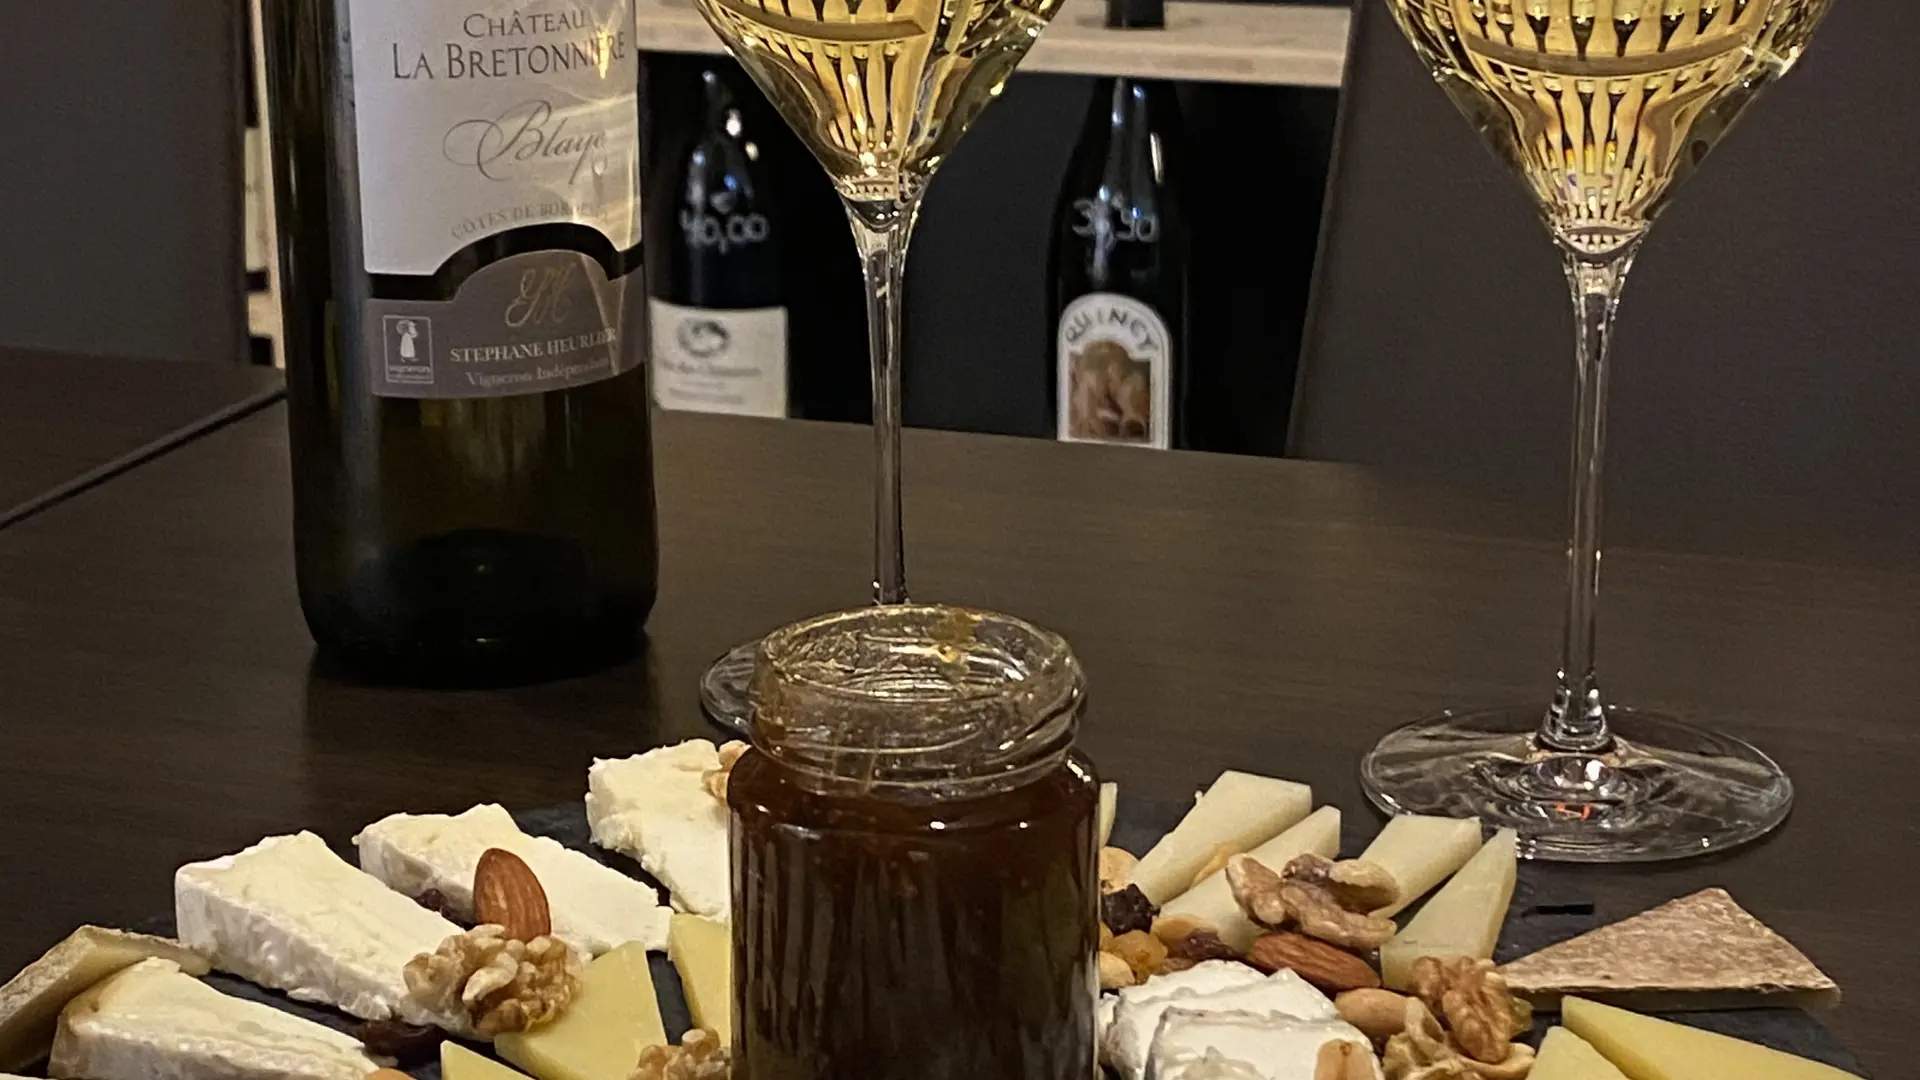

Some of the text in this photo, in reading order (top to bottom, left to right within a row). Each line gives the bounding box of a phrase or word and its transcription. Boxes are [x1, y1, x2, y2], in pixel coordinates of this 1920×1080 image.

[463, 9, 585, 38] CHÂTEAU
[391, 43, 434, 79] LA
[442, 99, 606, 186] Blaye
[513, 203, 535, 221] DE
[1065, 307, 1159, 350] QUINCY
